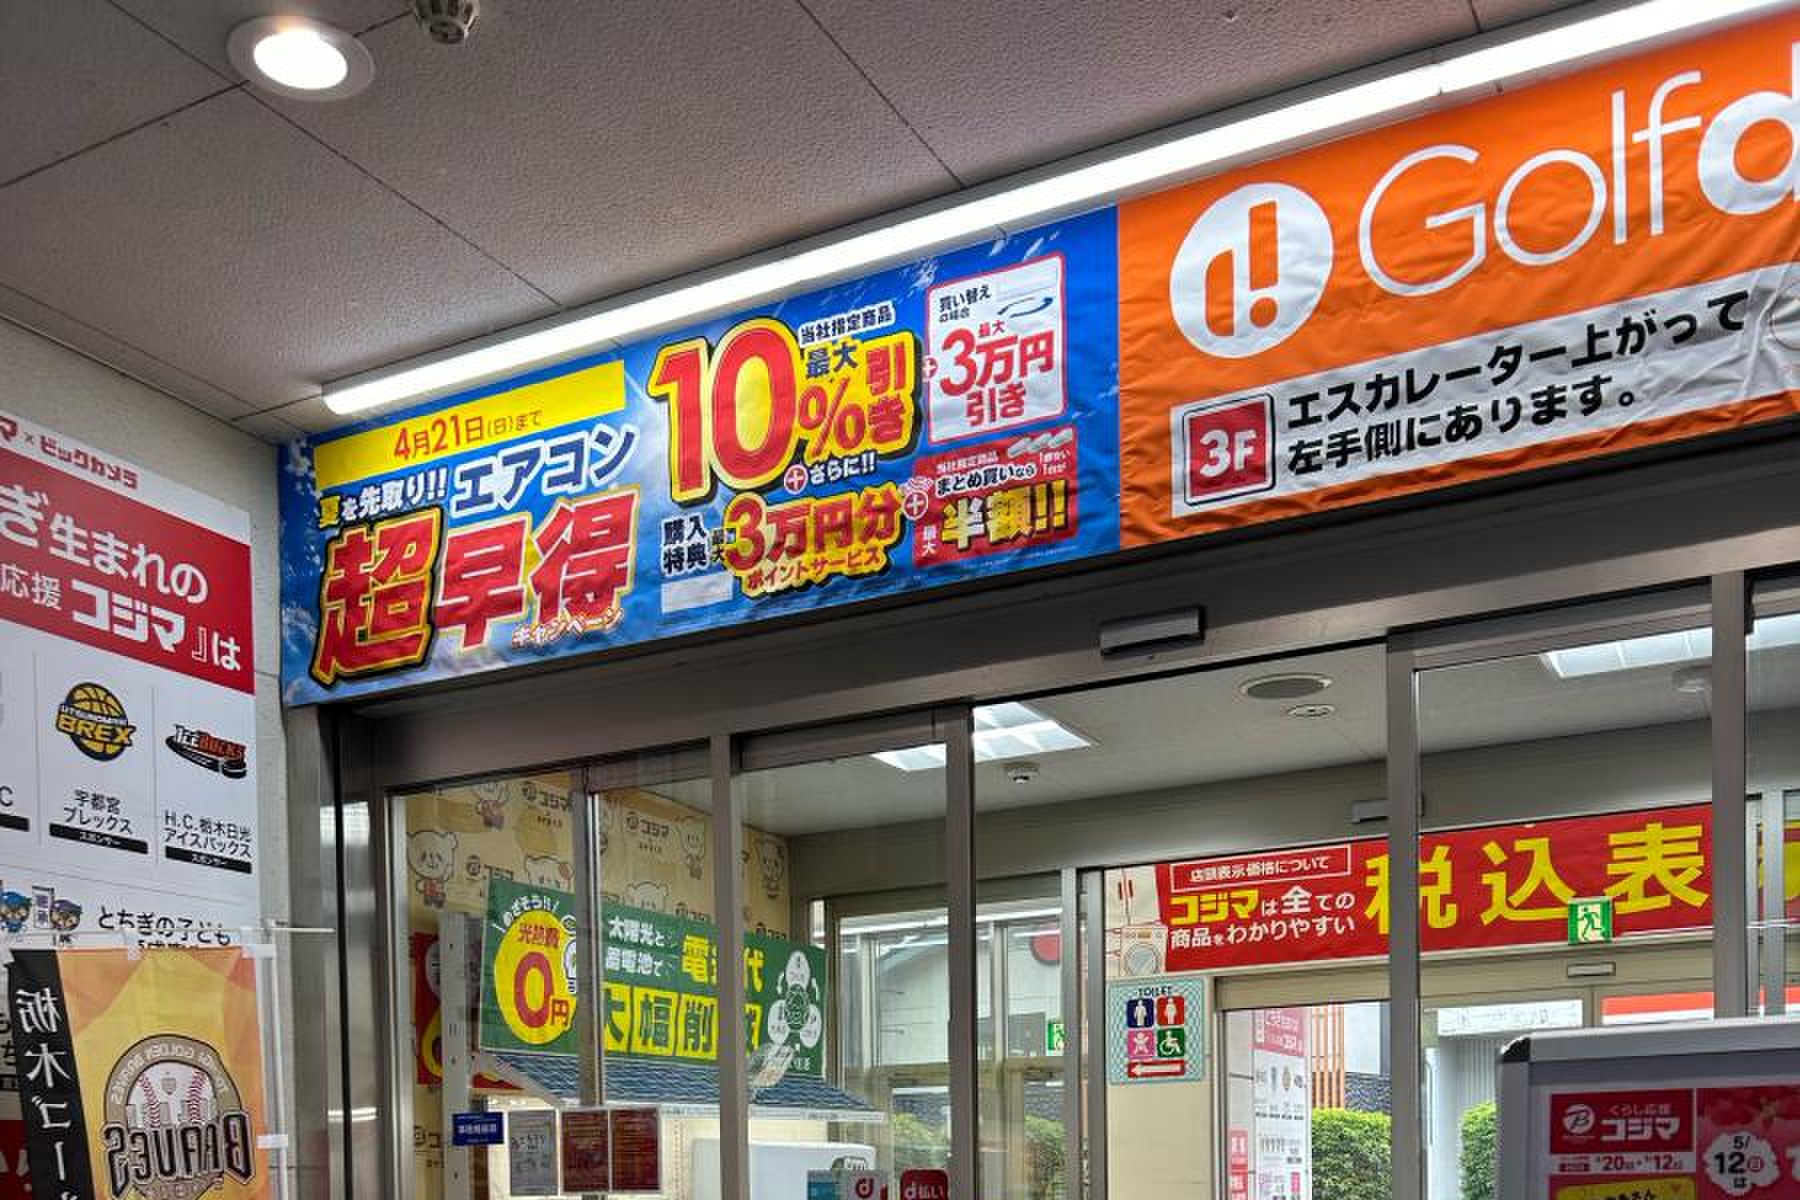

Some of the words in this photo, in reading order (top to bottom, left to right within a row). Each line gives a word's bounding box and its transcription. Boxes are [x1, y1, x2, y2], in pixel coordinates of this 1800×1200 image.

[939, 285, 992, 313] 買い替え
[800, 302, 894, 345] 当社指定商品
[979, 319, 1005, 338] 最大
[805, 342, 858, 379] 最大
[939, 328, 1055, 397] 3万円
[1286, 290, 1749, 429] エスカレーター上がって
[966, 380, 1026, 427] 引き
[1286, 376, 1635, 476] 左手側にあります。
[1199, 428, 1256, 478] 3F
[452, 426, 639, 517] エアコン
[937, 463, 1036, 496] まとめ買いなら
[663, 517, 706, 546] 購入
[726, 488, 900, 571] 3万円分
[663, 545, 706, 575] 特典
[747, 547, 884, 593] ポイントサービス
[312, 488, 640, 687] 超早得
[57, 713, 136, 746] BREX
[74, 788, 121, 816] 宇都宮
[63, 807, 134, 835] ブレックス
[163, 828, 252, 859] アイスバックス
[1170, 885, 1355, 926] コジマは全ての
[608, 915, 665, 948] 太陽光と
[1170, 916, 1355, 949] 商品をわかりやすい
[1138, 985, 1173, 997] TOILET
[1600, 1116, 1681, 1142] コジマ
